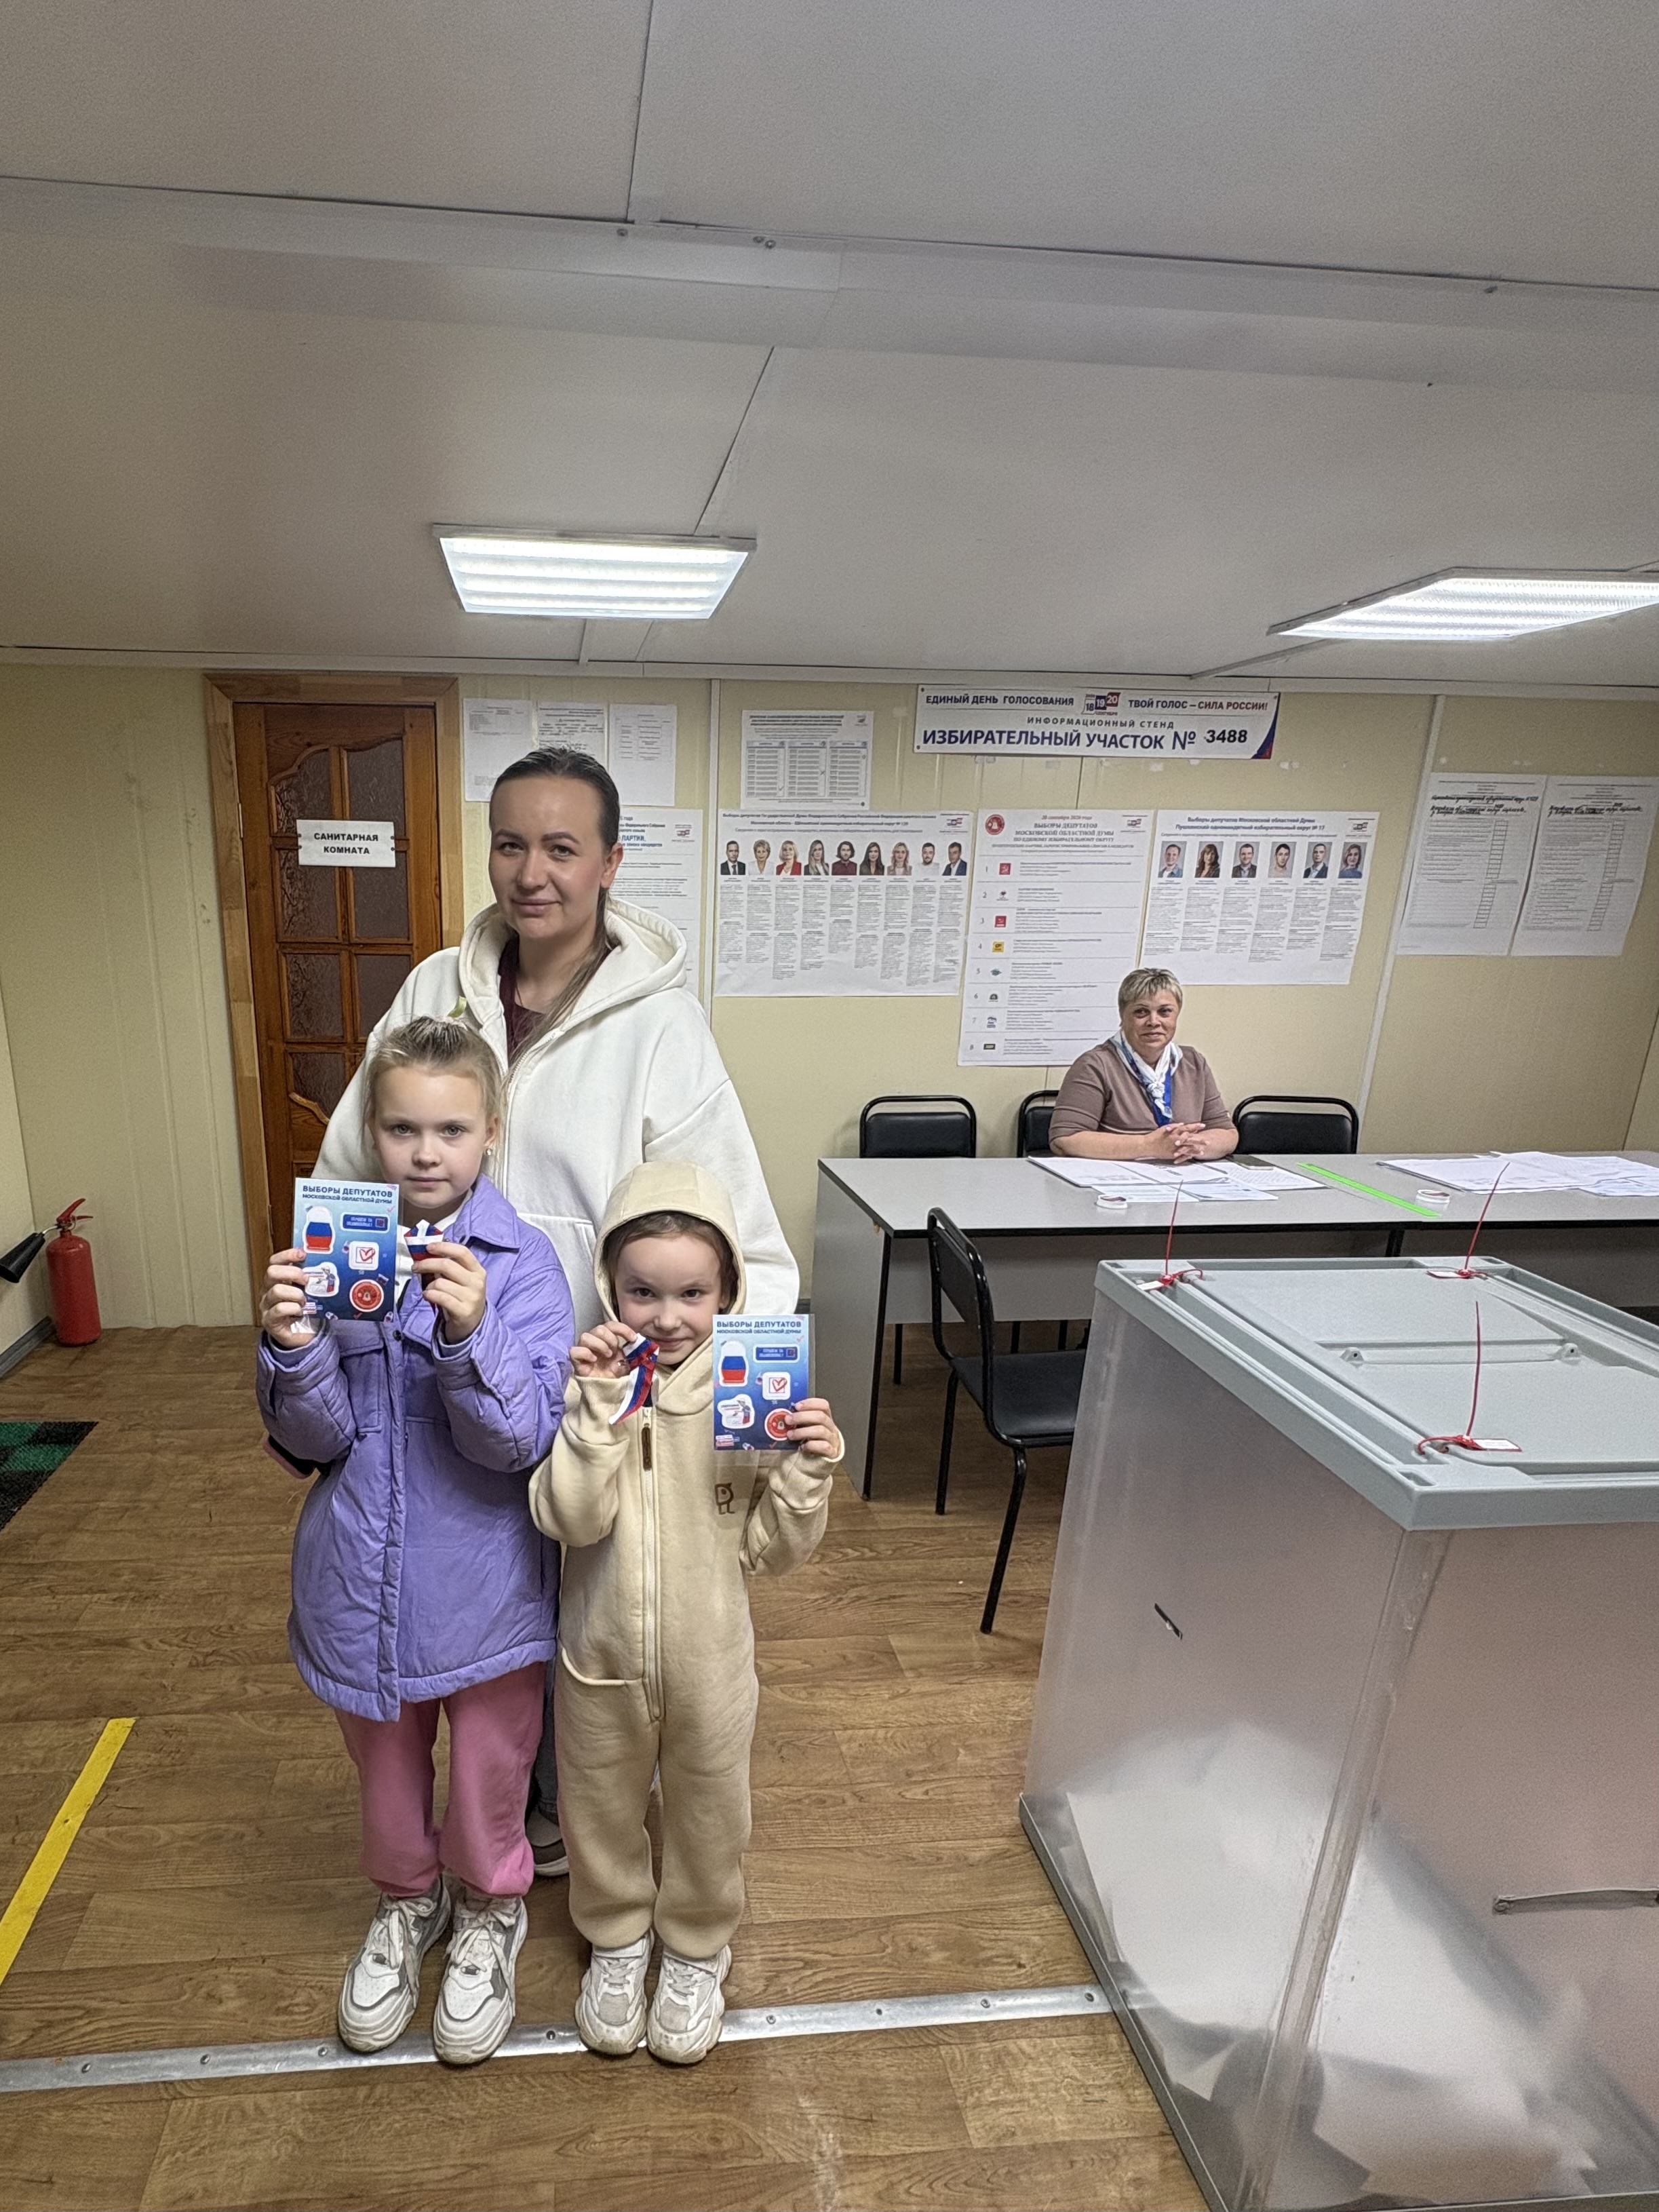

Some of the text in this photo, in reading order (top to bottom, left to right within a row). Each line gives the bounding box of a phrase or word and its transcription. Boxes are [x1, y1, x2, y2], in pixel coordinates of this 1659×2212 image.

[926, 693, 1074, 706] ЕДИНЫЙ ДЕНЬ ГОЛОСОВАНИЯ
[1096, 699, 1106, 707] 19
[1106, 695, 1118, 704] 20
[1128, 698, 1154, 709] ТВОЙ
[1156, 700, 1188, 710] ГОЛОС
[1198, 701, 1224, 710] СИЛА
[1226, 701, 1268, 711] РОССИИ!
[1086, 703, 1095, 712] 18
[1027, 716, 1175, 730] ИНФОРМАЦИОННЫЙ СТЕНД
[923, 729, 1248, 750] ИЗБИРАТЕЛЬНЫЙ УЧАСТОК № 3488
[314, 832, 379, 842] САНИТАРНАЯ
[324, 846, 370, 855] КОМНАТА
[302, 1185, 393, 1198] ВЫБОРЫ ДЕПУТАТОВ
[754, 1321, 802, 1329] ДЕПУТАТОВ
